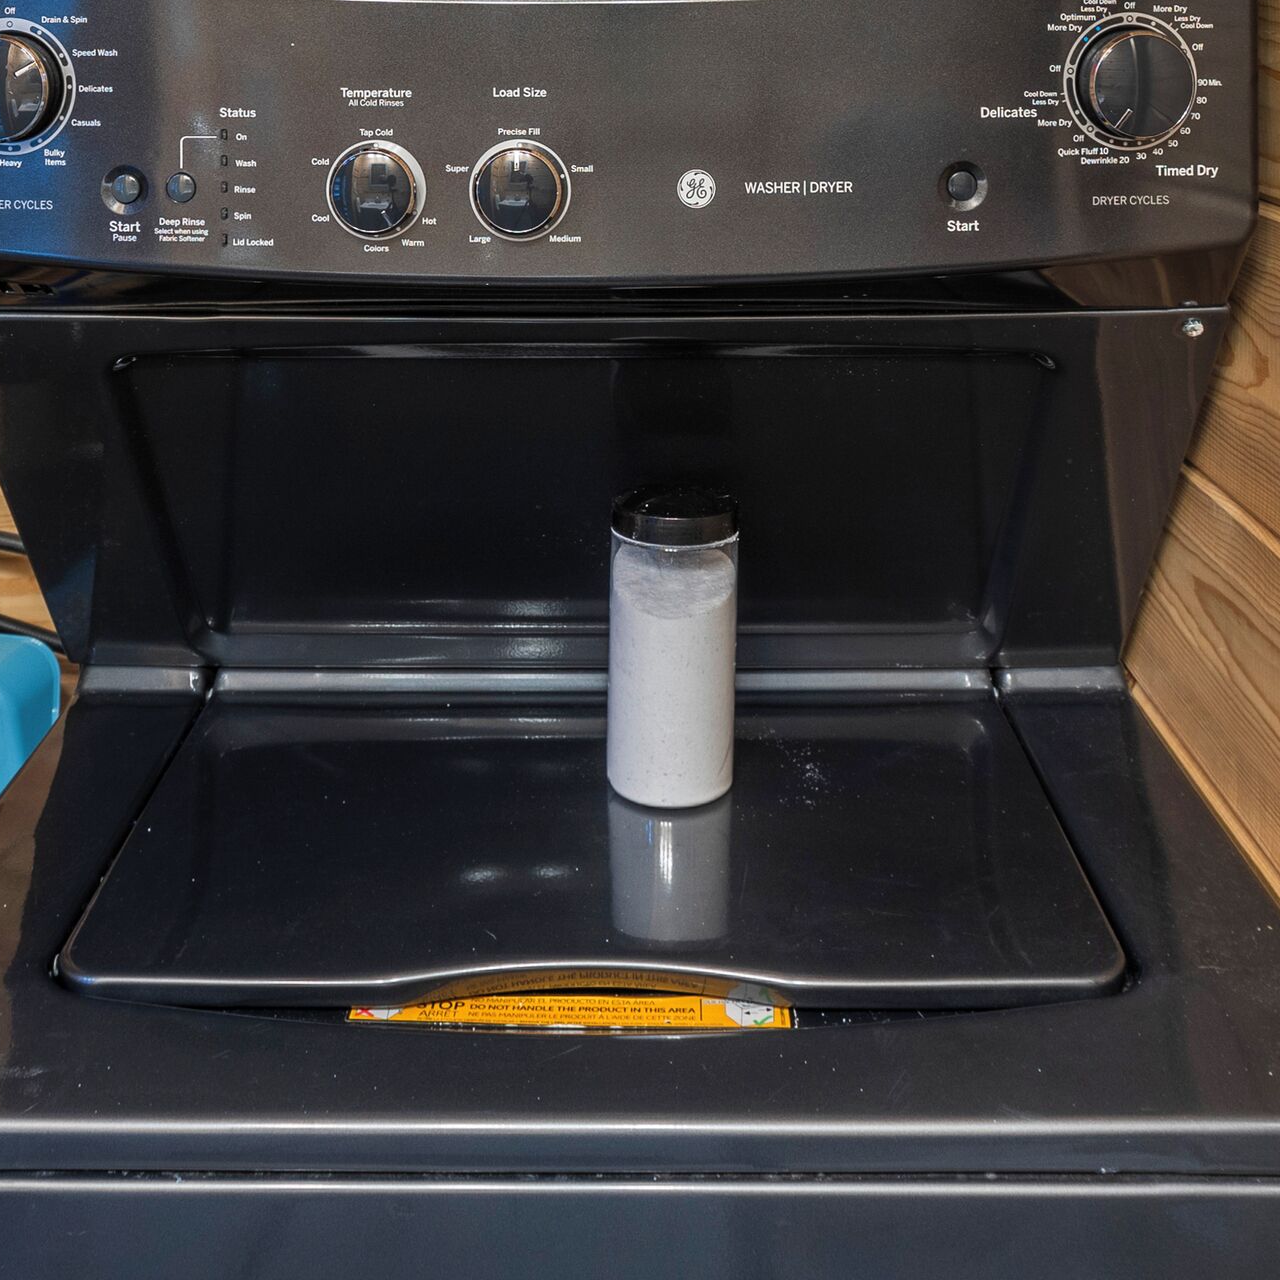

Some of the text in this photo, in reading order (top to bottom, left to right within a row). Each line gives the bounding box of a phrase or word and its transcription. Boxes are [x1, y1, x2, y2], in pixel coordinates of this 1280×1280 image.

[4, 6, 16, 15] Off
[1174, 6, 1187, 14] Dry
[41, 16, 88, 25] Drain & Spin
[1060, 13, 1096, 22] Optimum
[1069, 24, 1082, 33] Dry
[72, 49, 118, 58] Speed Wash
[78, 85, 113, 93] Delicates
[493, 88, 547, 98] Load Size
[340, 88, 412, 100] Temperature
[348, 99, 404, 107] All Cold Rinses
[220, 107, 256, 118] Status
[981, 107, 1038, 118] Delicates
[71, 119, 101, 127] Casuals
[1059, 119, 1072, 128] Dry
[360, 129, 374, 137] Tap
[498, 128, 540, 136] Precise Fill
[1180, 127, 1191, 135] 60
[236, 133, 247, 141] On
[44, 149, 65, 158] Bulky
[1058, 148, 1080, 157] Quick
[1153, 148, 1164, 156] 40
[0, 159, 22, 168] Heavy
[45, 158, 66, 166] Items
[235, 160, 257, 168] Wash
[311, 158, 330, 166] Cold
[1119, 156, 1130, 164] 20
[445, 165, 469, 174] Super
[571, 165, 594, 173] Small
[1155, 165, 1219, 178] Timed Dry
[234, 186, 256, 194] Rinse
[745, 181, 853, 194] WASHER DRYER
[14, 200, 53, 210] CYCLES
[1093, 195, 1170, 206] DRYER CYCLES
[234, 212, 252, 221] Spin
[312, 214, 330, 222] Cool
[422, 217, 437, 225] Hot
[109, 221, 141, 233] Start
[159, 218, 206, 228] Deep Rinse
[947, 220, 980, 232] Start
[113, 234, 137, 242] Pause
[233, 238, 274, 246] Lid Locked
[469, 235, 492, 244] Large
[549, 235, 582, 243] Medium
[402, 239, 424, 247] Warm
[364, 245, 390, 253] Colors
